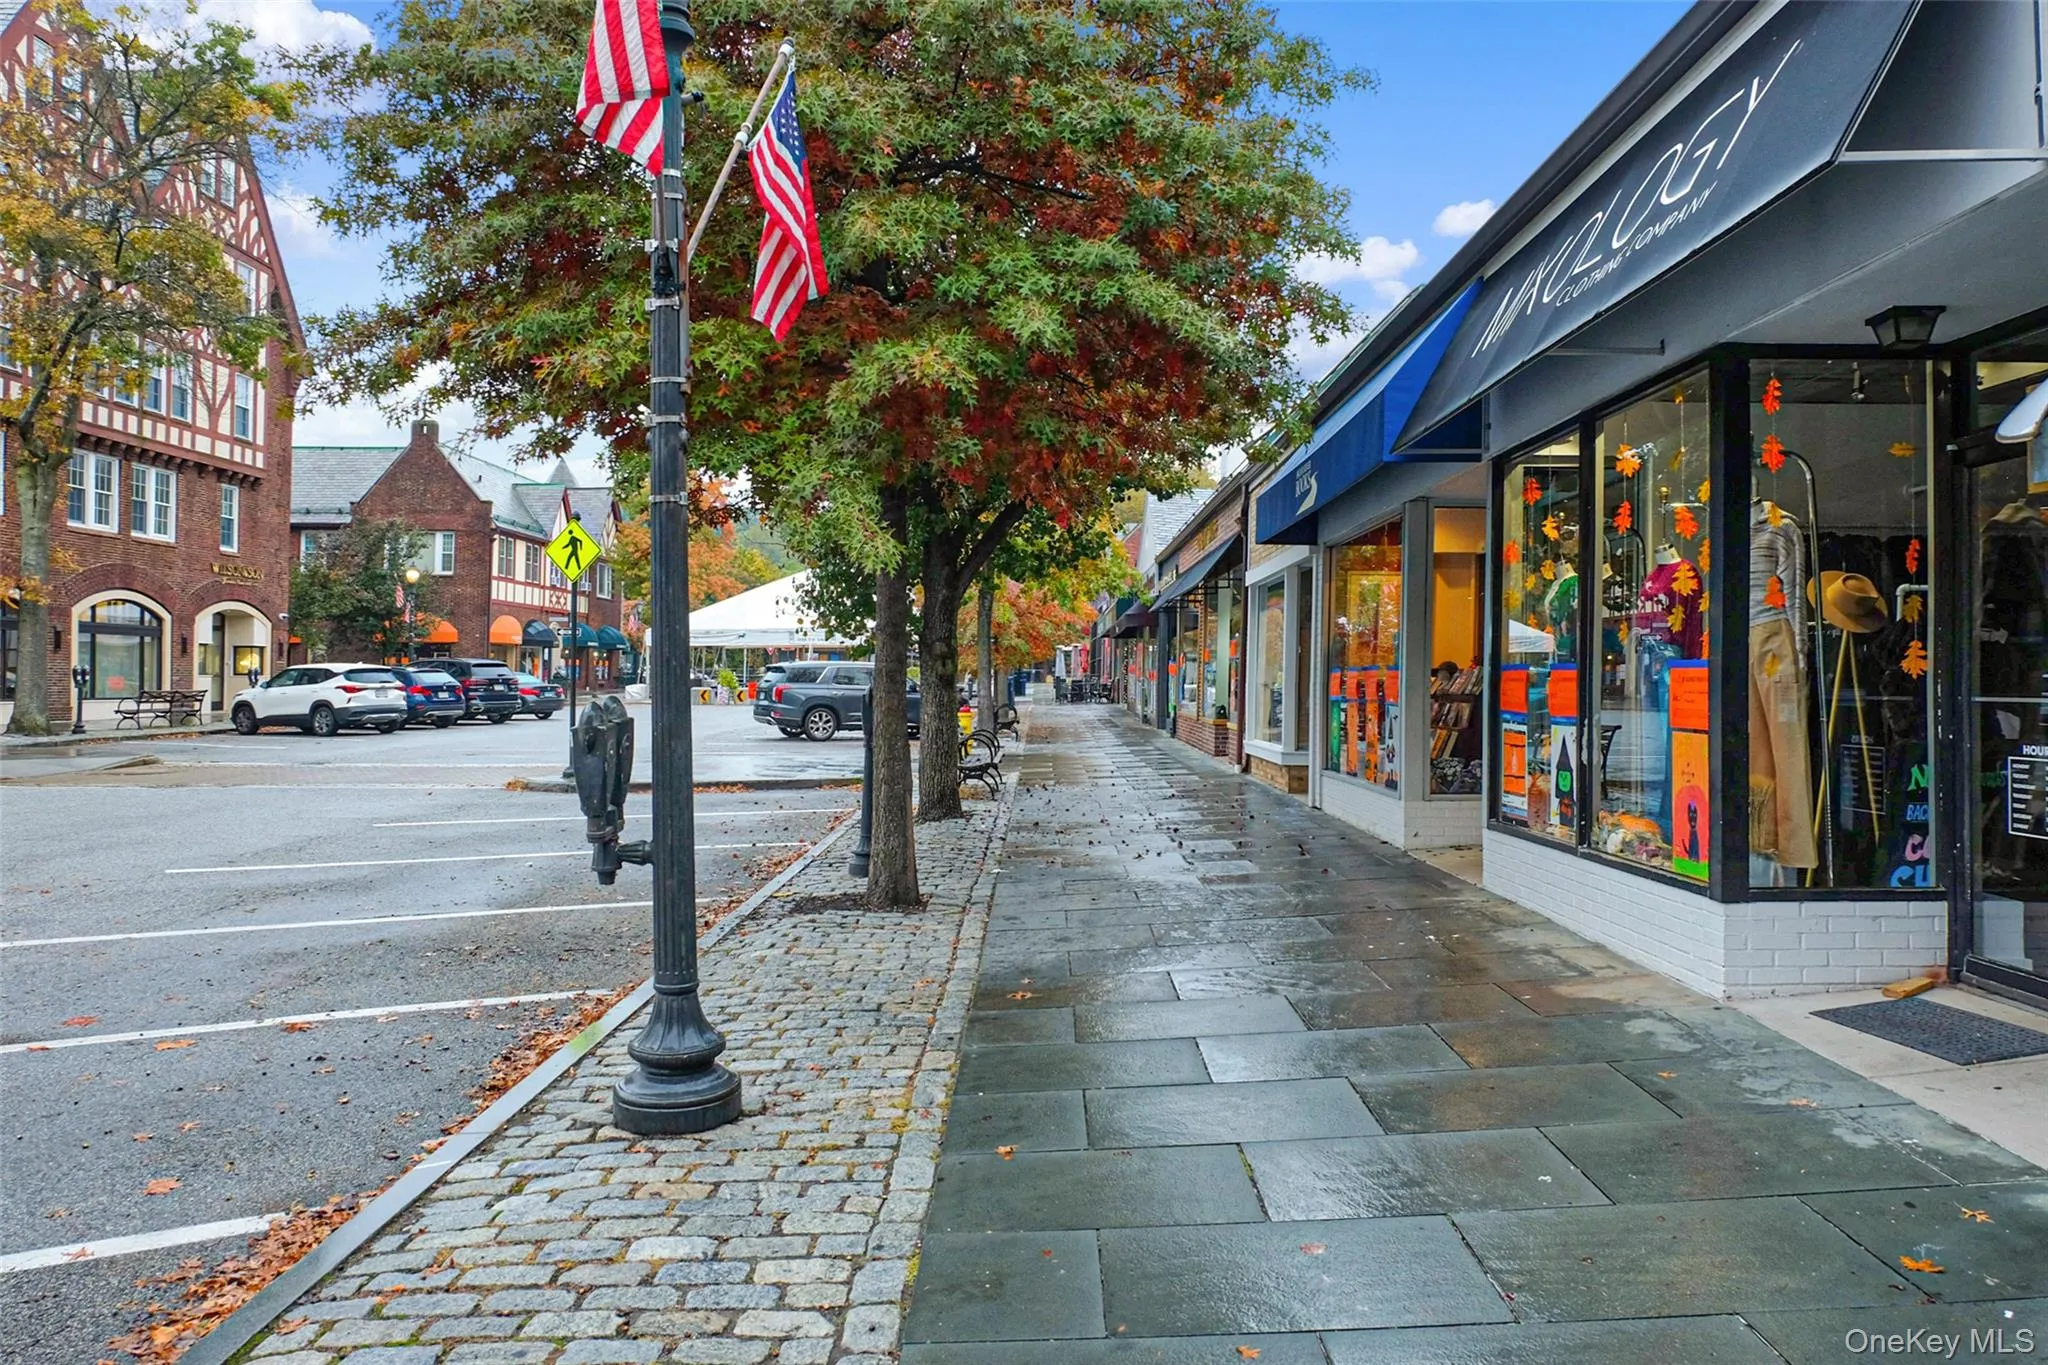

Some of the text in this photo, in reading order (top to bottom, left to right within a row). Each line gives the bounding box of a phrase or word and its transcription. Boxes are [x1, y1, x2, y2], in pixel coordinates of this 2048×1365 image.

[1471, 39, 1801, 358] MAYOLOGY
[1556, 180, 1718, 306] CLOTHING COMPANY
